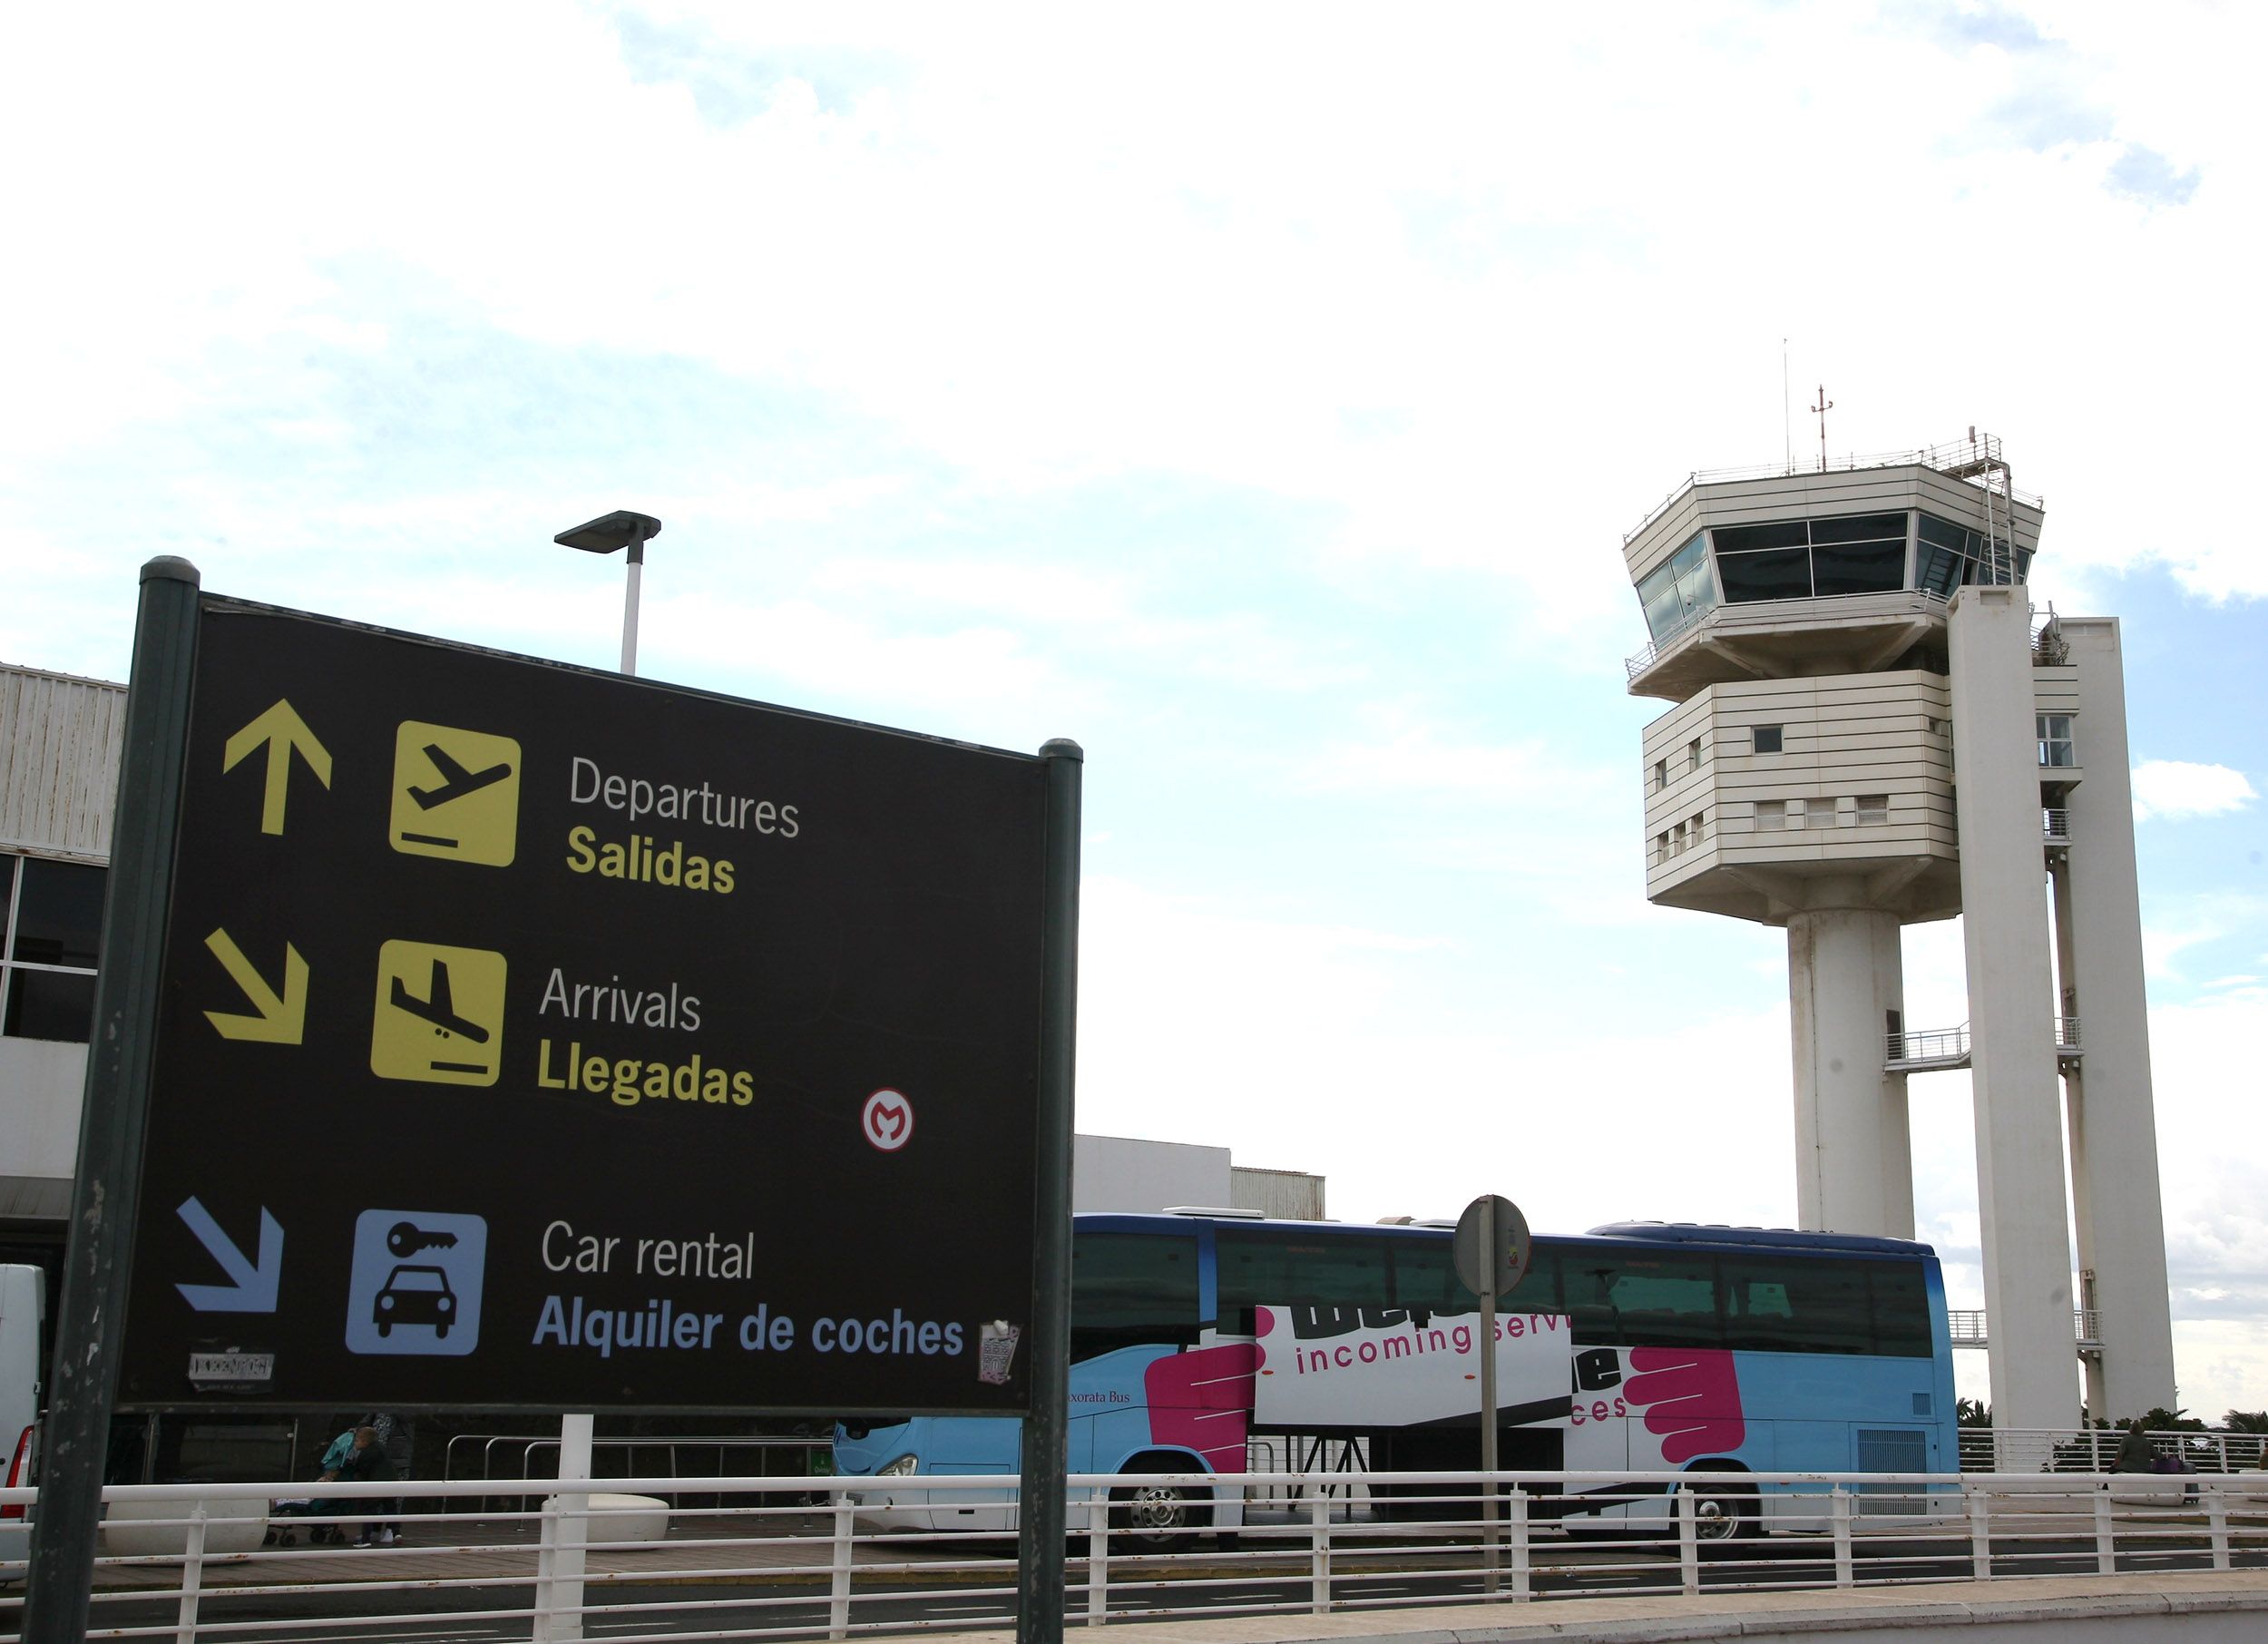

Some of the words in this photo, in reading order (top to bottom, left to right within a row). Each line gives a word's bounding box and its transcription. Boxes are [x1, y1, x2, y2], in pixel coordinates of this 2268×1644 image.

[571, 756, 800, 838] Departures
[566, 825, 736, 894] Salidas
[538, 967, 701, 1032] Arrivals
[537, 1038, 755, 1106] Llegadas
[542, 1220, 621, 1273] Car
[636, 1231, 755, 1280] rental
[532, 1294, 723, 1358] Alquiler
[738, 1303, 796, 1354] de
[810, 1306, 964, 1356] coches
[1295, 1326, 1471, 1375] incoming
[1109, 1390, 1130, 1403] Bus
[1570, 1396, 1627, 1427] ces
